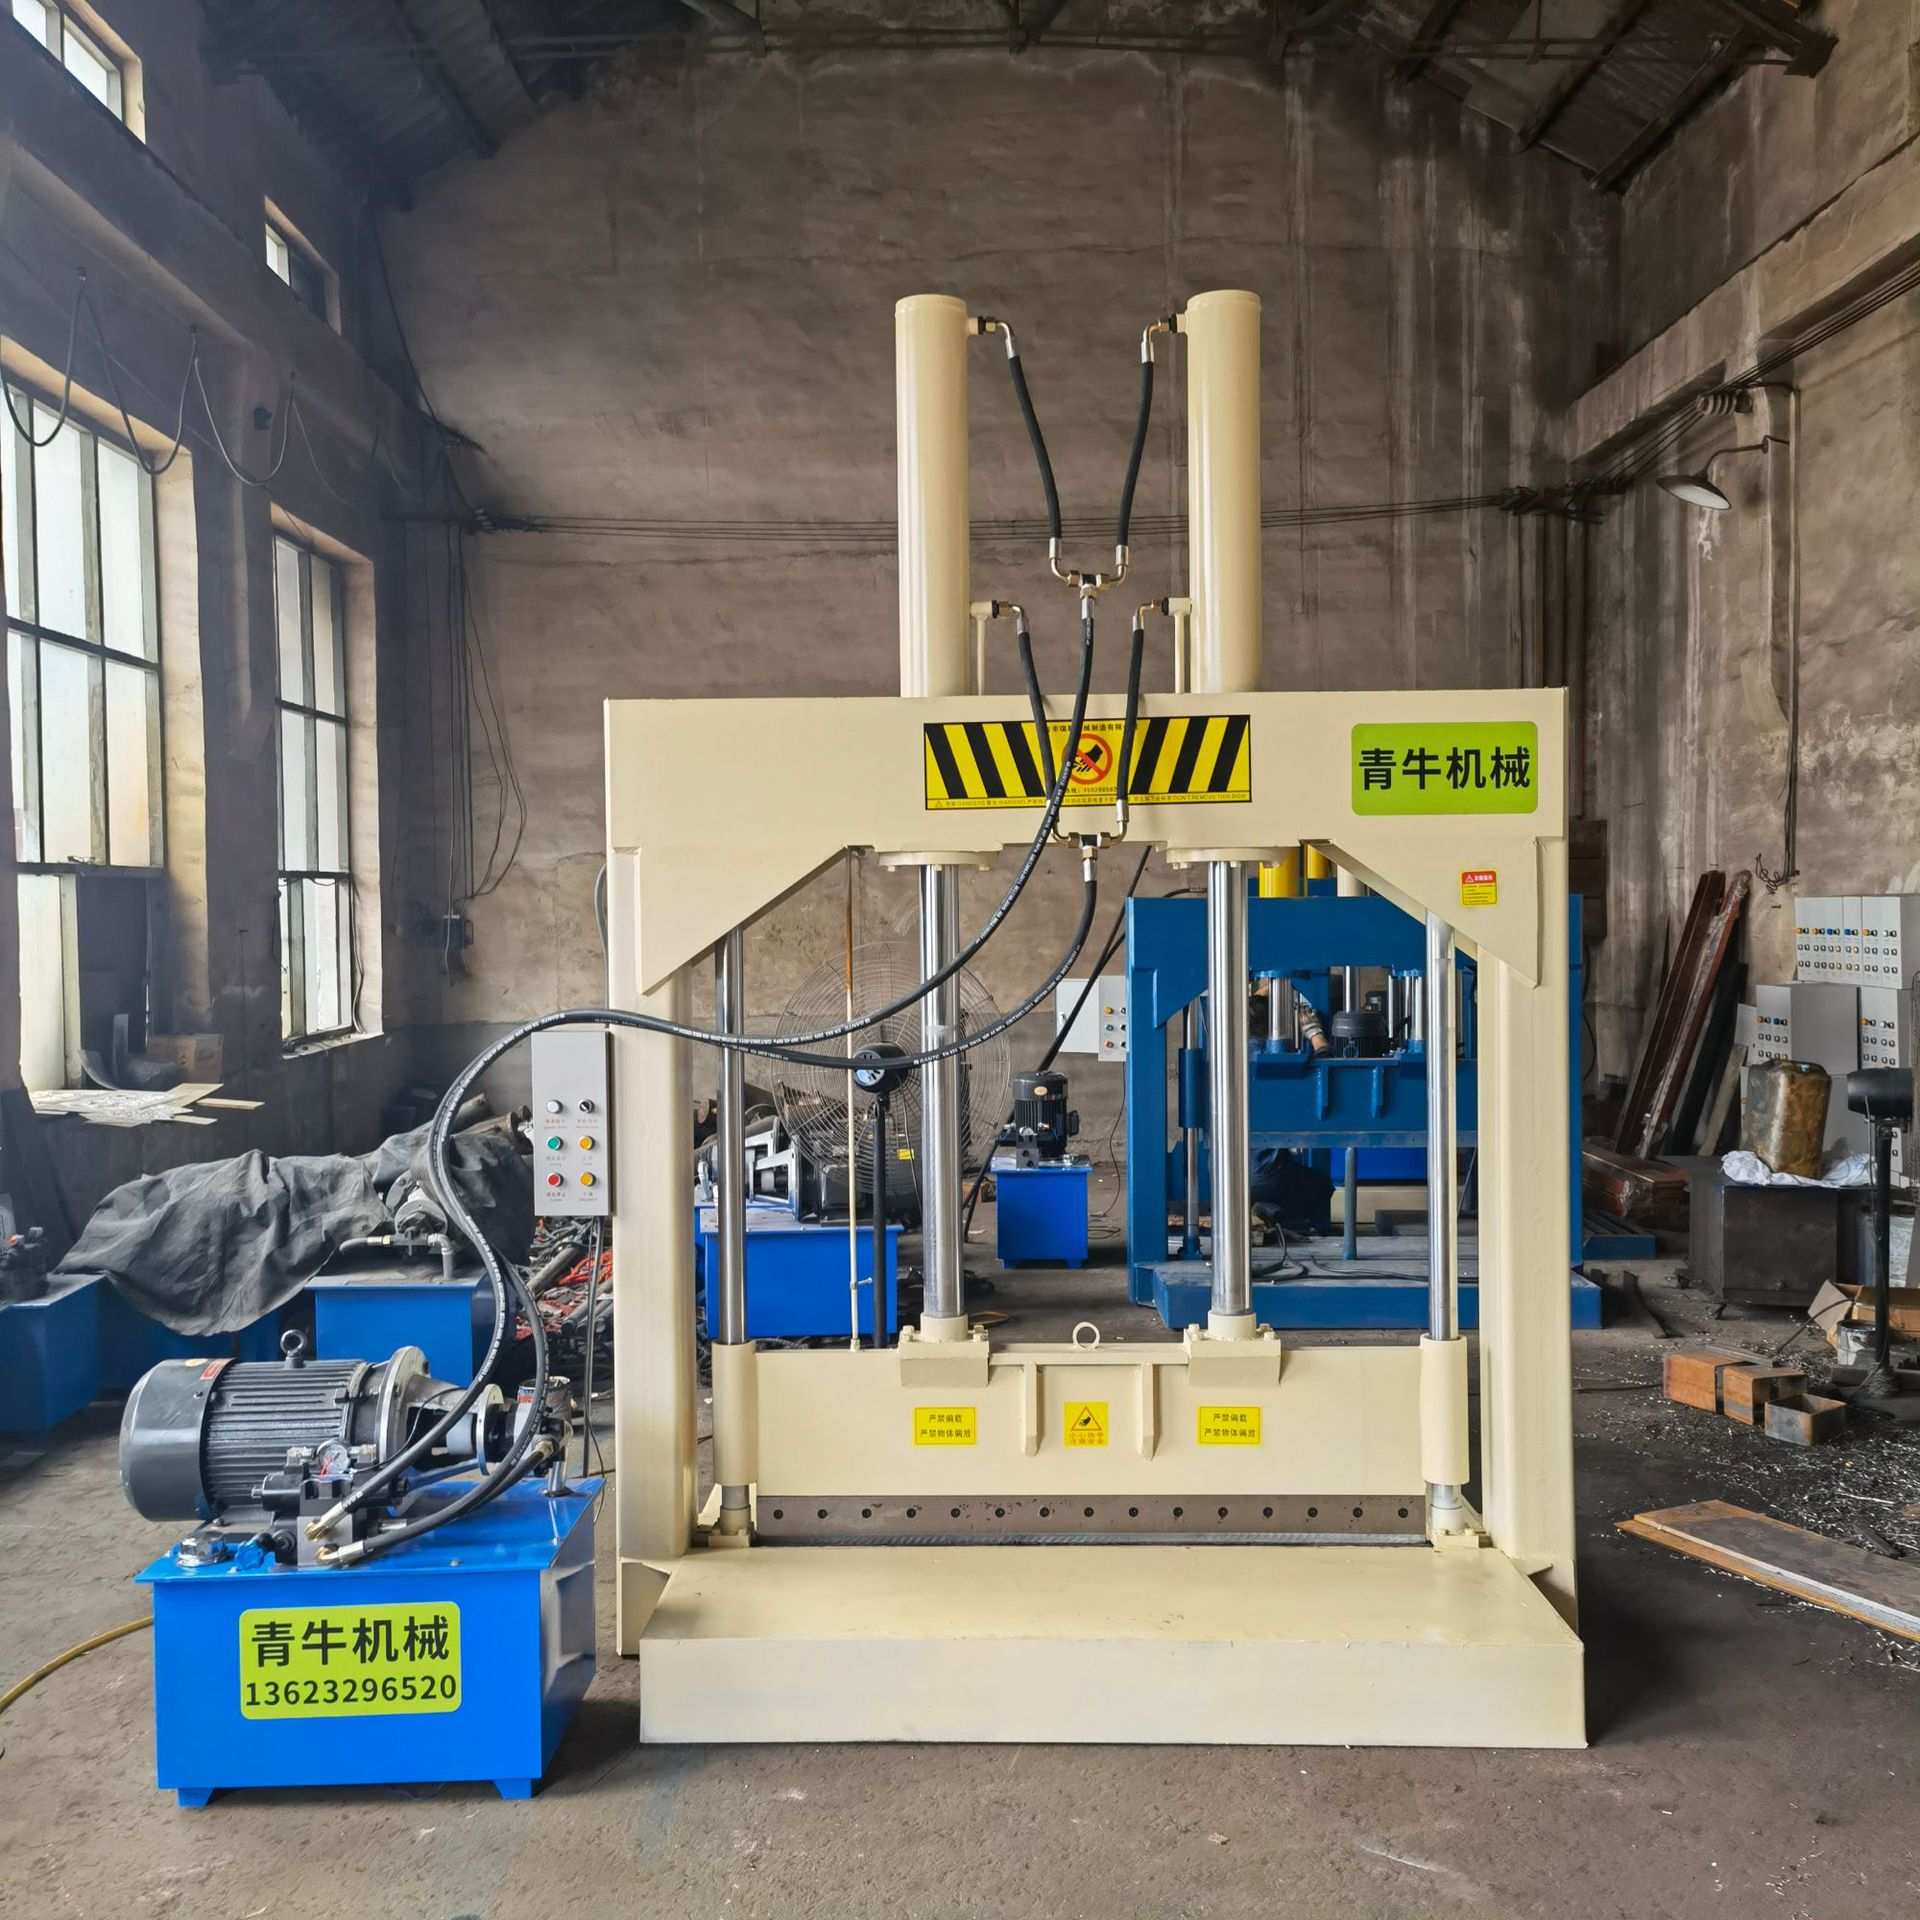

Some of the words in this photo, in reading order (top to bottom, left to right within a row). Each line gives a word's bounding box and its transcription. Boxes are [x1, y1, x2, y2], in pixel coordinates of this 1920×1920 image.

[1358, 746, 1531, 791] 青牛机械
[251, 1615, 450, 1668] 青牛机械
[246, 1674, 457, 1706] 13623296520
